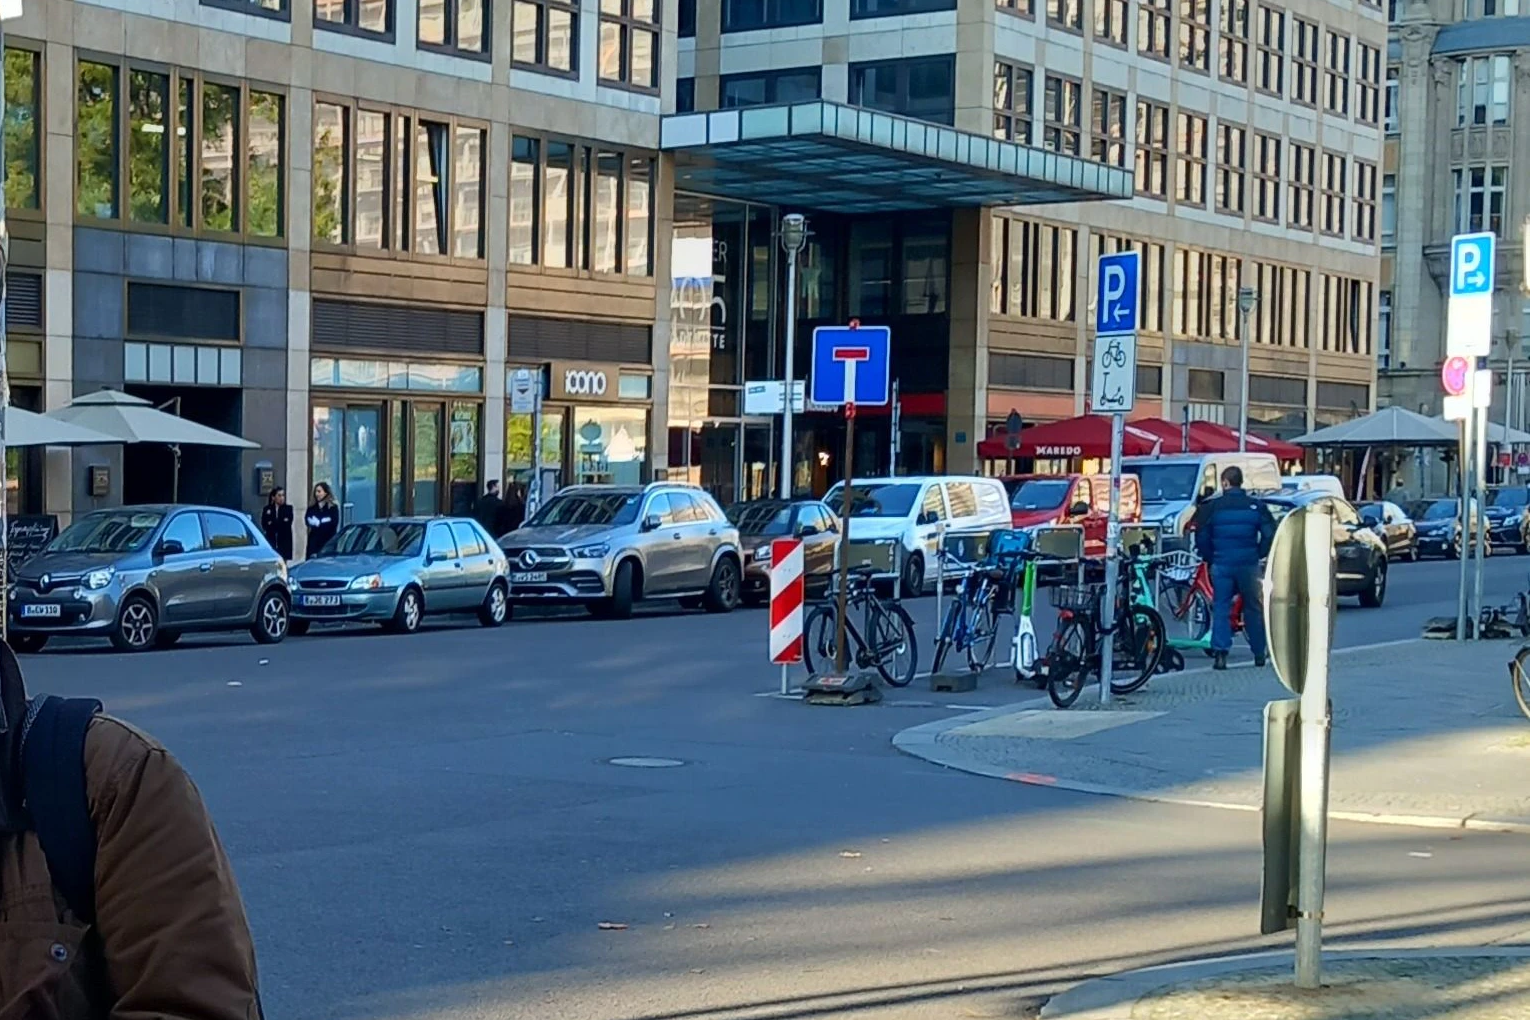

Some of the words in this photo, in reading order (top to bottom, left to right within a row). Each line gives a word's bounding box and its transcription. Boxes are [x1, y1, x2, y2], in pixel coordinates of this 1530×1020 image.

[1457, 243, 1480, 290] P
[1102, 264, 1126, 324] P
[1035, 445, 1082, 456] MAREDO
